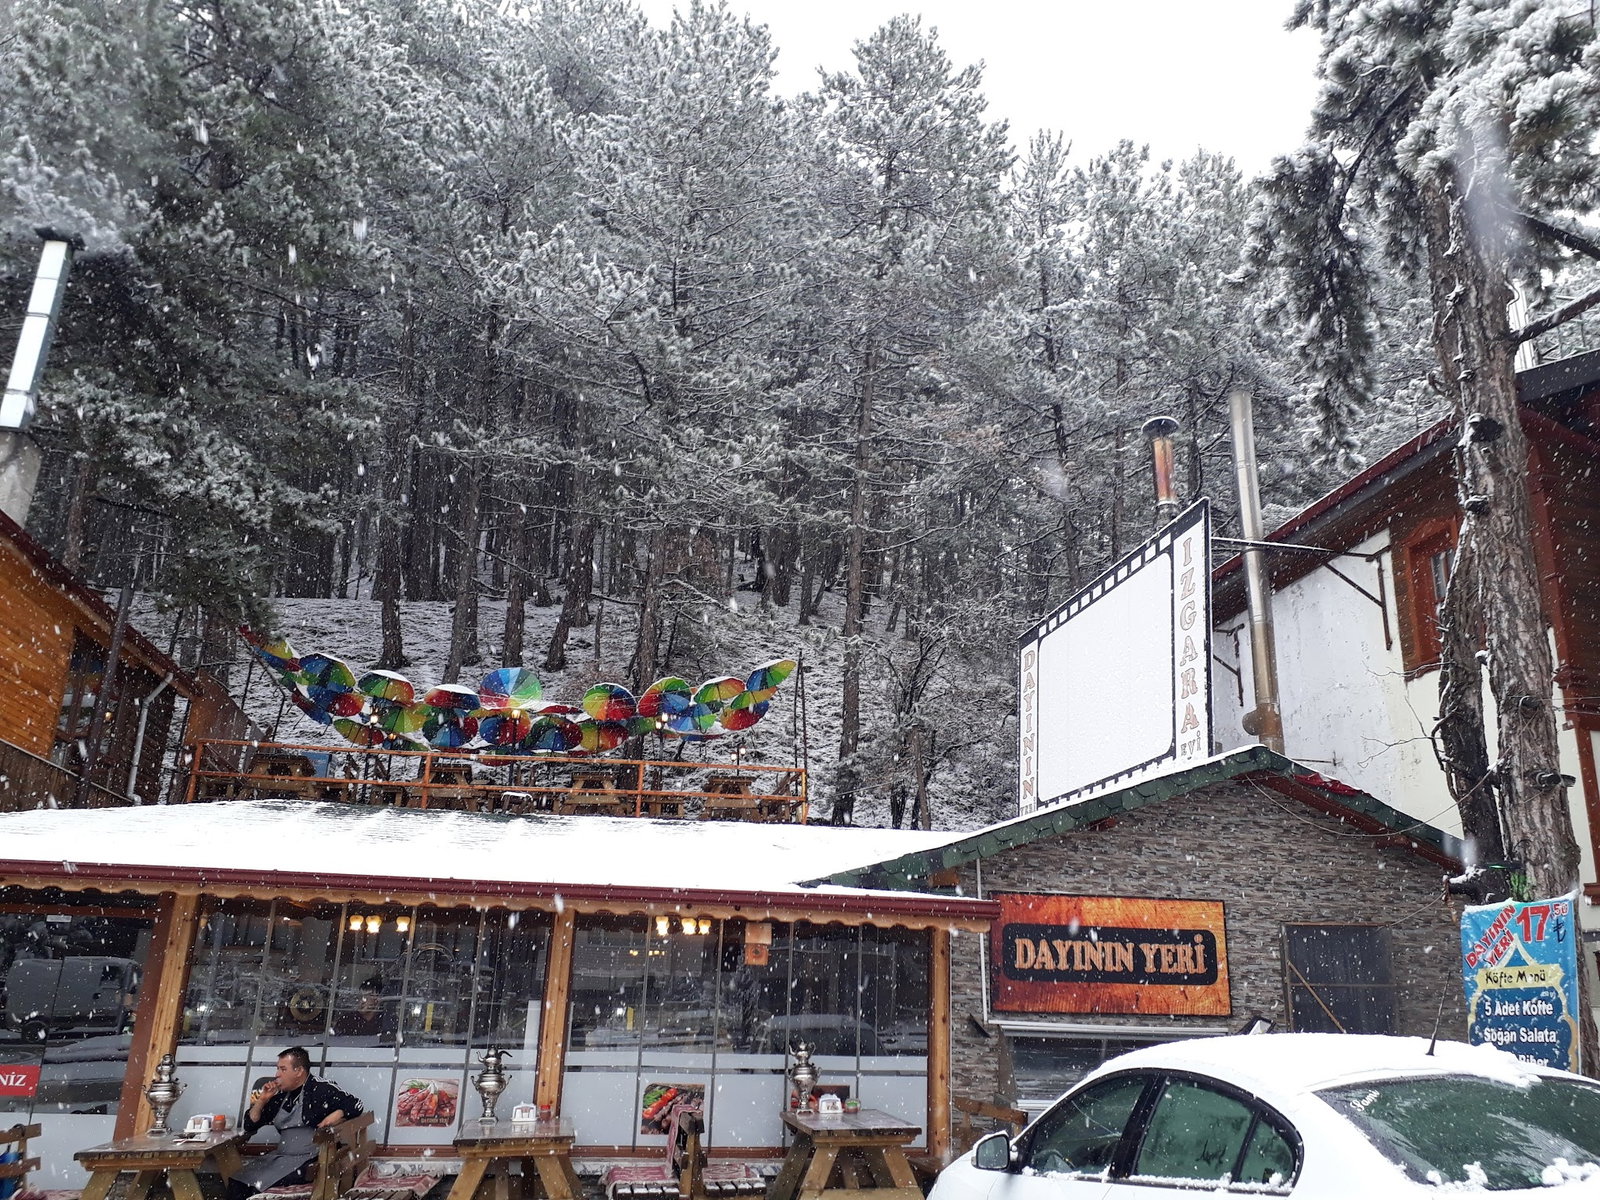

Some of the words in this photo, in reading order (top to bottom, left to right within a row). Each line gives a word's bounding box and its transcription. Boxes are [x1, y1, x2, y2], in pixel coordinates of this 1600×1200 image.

[1179, 536, 1200, 735] IZGARA
[1022, 648, 1037, 800] DAYININ
[1465, 904, 1516, 969] DAYININ
[1515, 904, 1551, 942] 17
[1014, 937, 1134, 973] DAYININ
[1139, 933, 1207, 975] YERİ
[1484, 928, 1515, 967] YERİ
[1485, 971, 1513, 988] Köfte
[1484, 1001, 1491, 1016] 5
[1495, 1001, 1520, 1016] Adet
[1519, 1026, 1557, 1043] Salata
